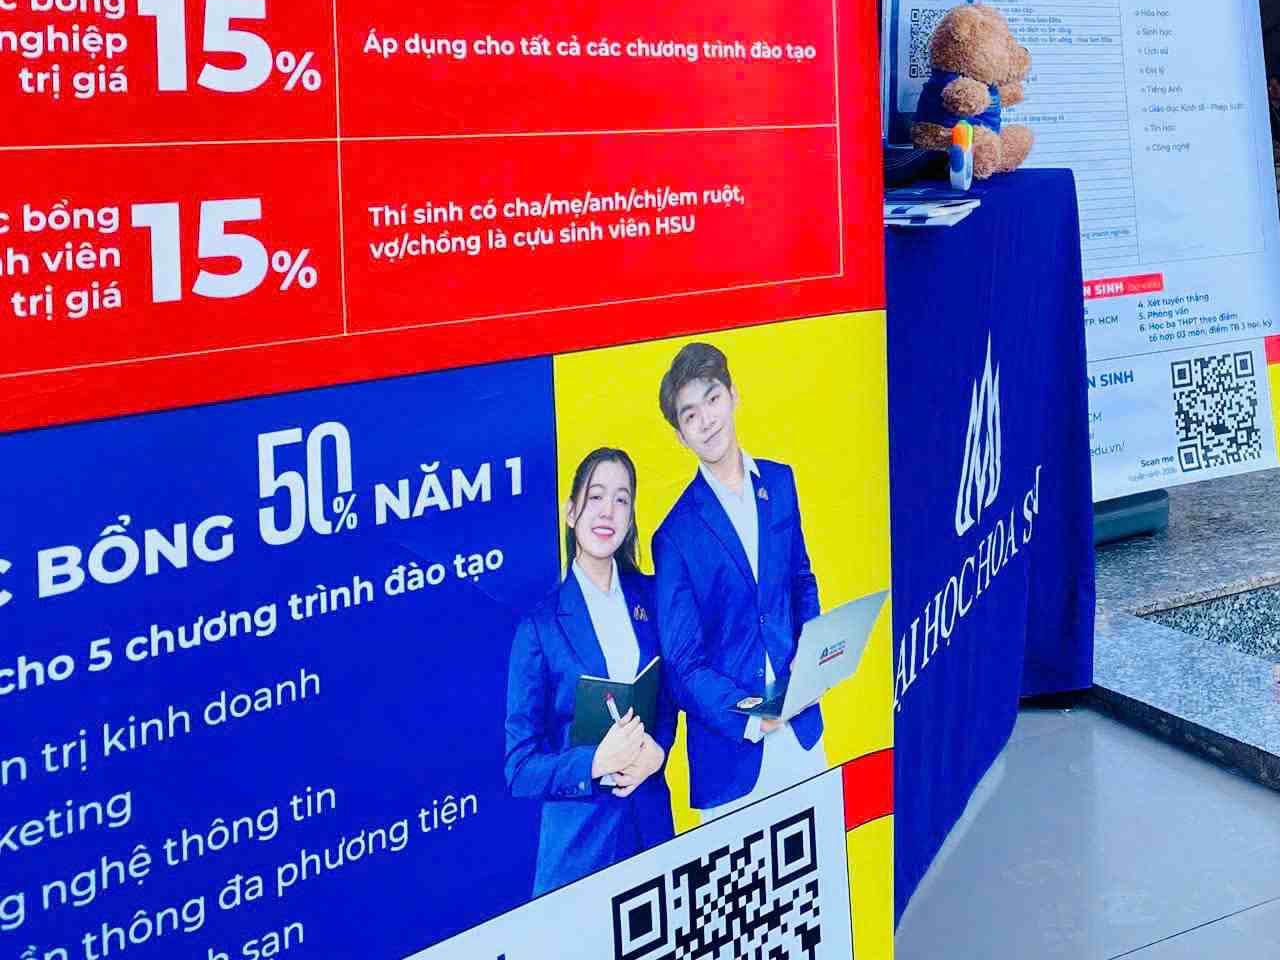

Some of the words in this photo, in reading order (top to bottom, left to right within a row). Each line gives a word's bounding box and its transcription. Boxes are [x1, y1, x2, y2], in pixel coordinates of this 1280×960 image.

[364, 29, 397, 58] Áp
[405, 33, 466, 59] dụng
[474, 36, 514, 54] cho
[520, 35, 551, 55] tất
[557, 36, 580, 56] cả
[587, 38, 620, 56] các
[627, 39, 698, 62] chương
[703, 40, 745, 58] trình
[751, 41, 782, 58] đào
[786, 44, 816, 62] tạo
[132, 198, 317, 302] 15%
[1095, 282, 1124, 296] SINH
[1100, 370, 1134, 387] SINH
[1140, 459, 1160, 468] Scan
[38, 515, 233, 597] BỔNG
[375, 462, 491, 524] NĂM
[505, 456, 523, 496] 1
[0, 656, 74, 694] cho
[88, 638, 112, 671] 5
[126, 604, 276, 661] chương
[288, 576, 373, 620] trình
[385, 562, 445, 595] đào
[454, 550, 503, 581] tạo
[43, 845, 151, 908] nghệ
[164, 807, 278, 865] thông
[290, 787, 335, 820] tin
[83, 897, 204, 960] thông
[219, 874, 262, 909] đa
[278, 820, 408, 896] phương
[419, 795, 476, 832] tiện
